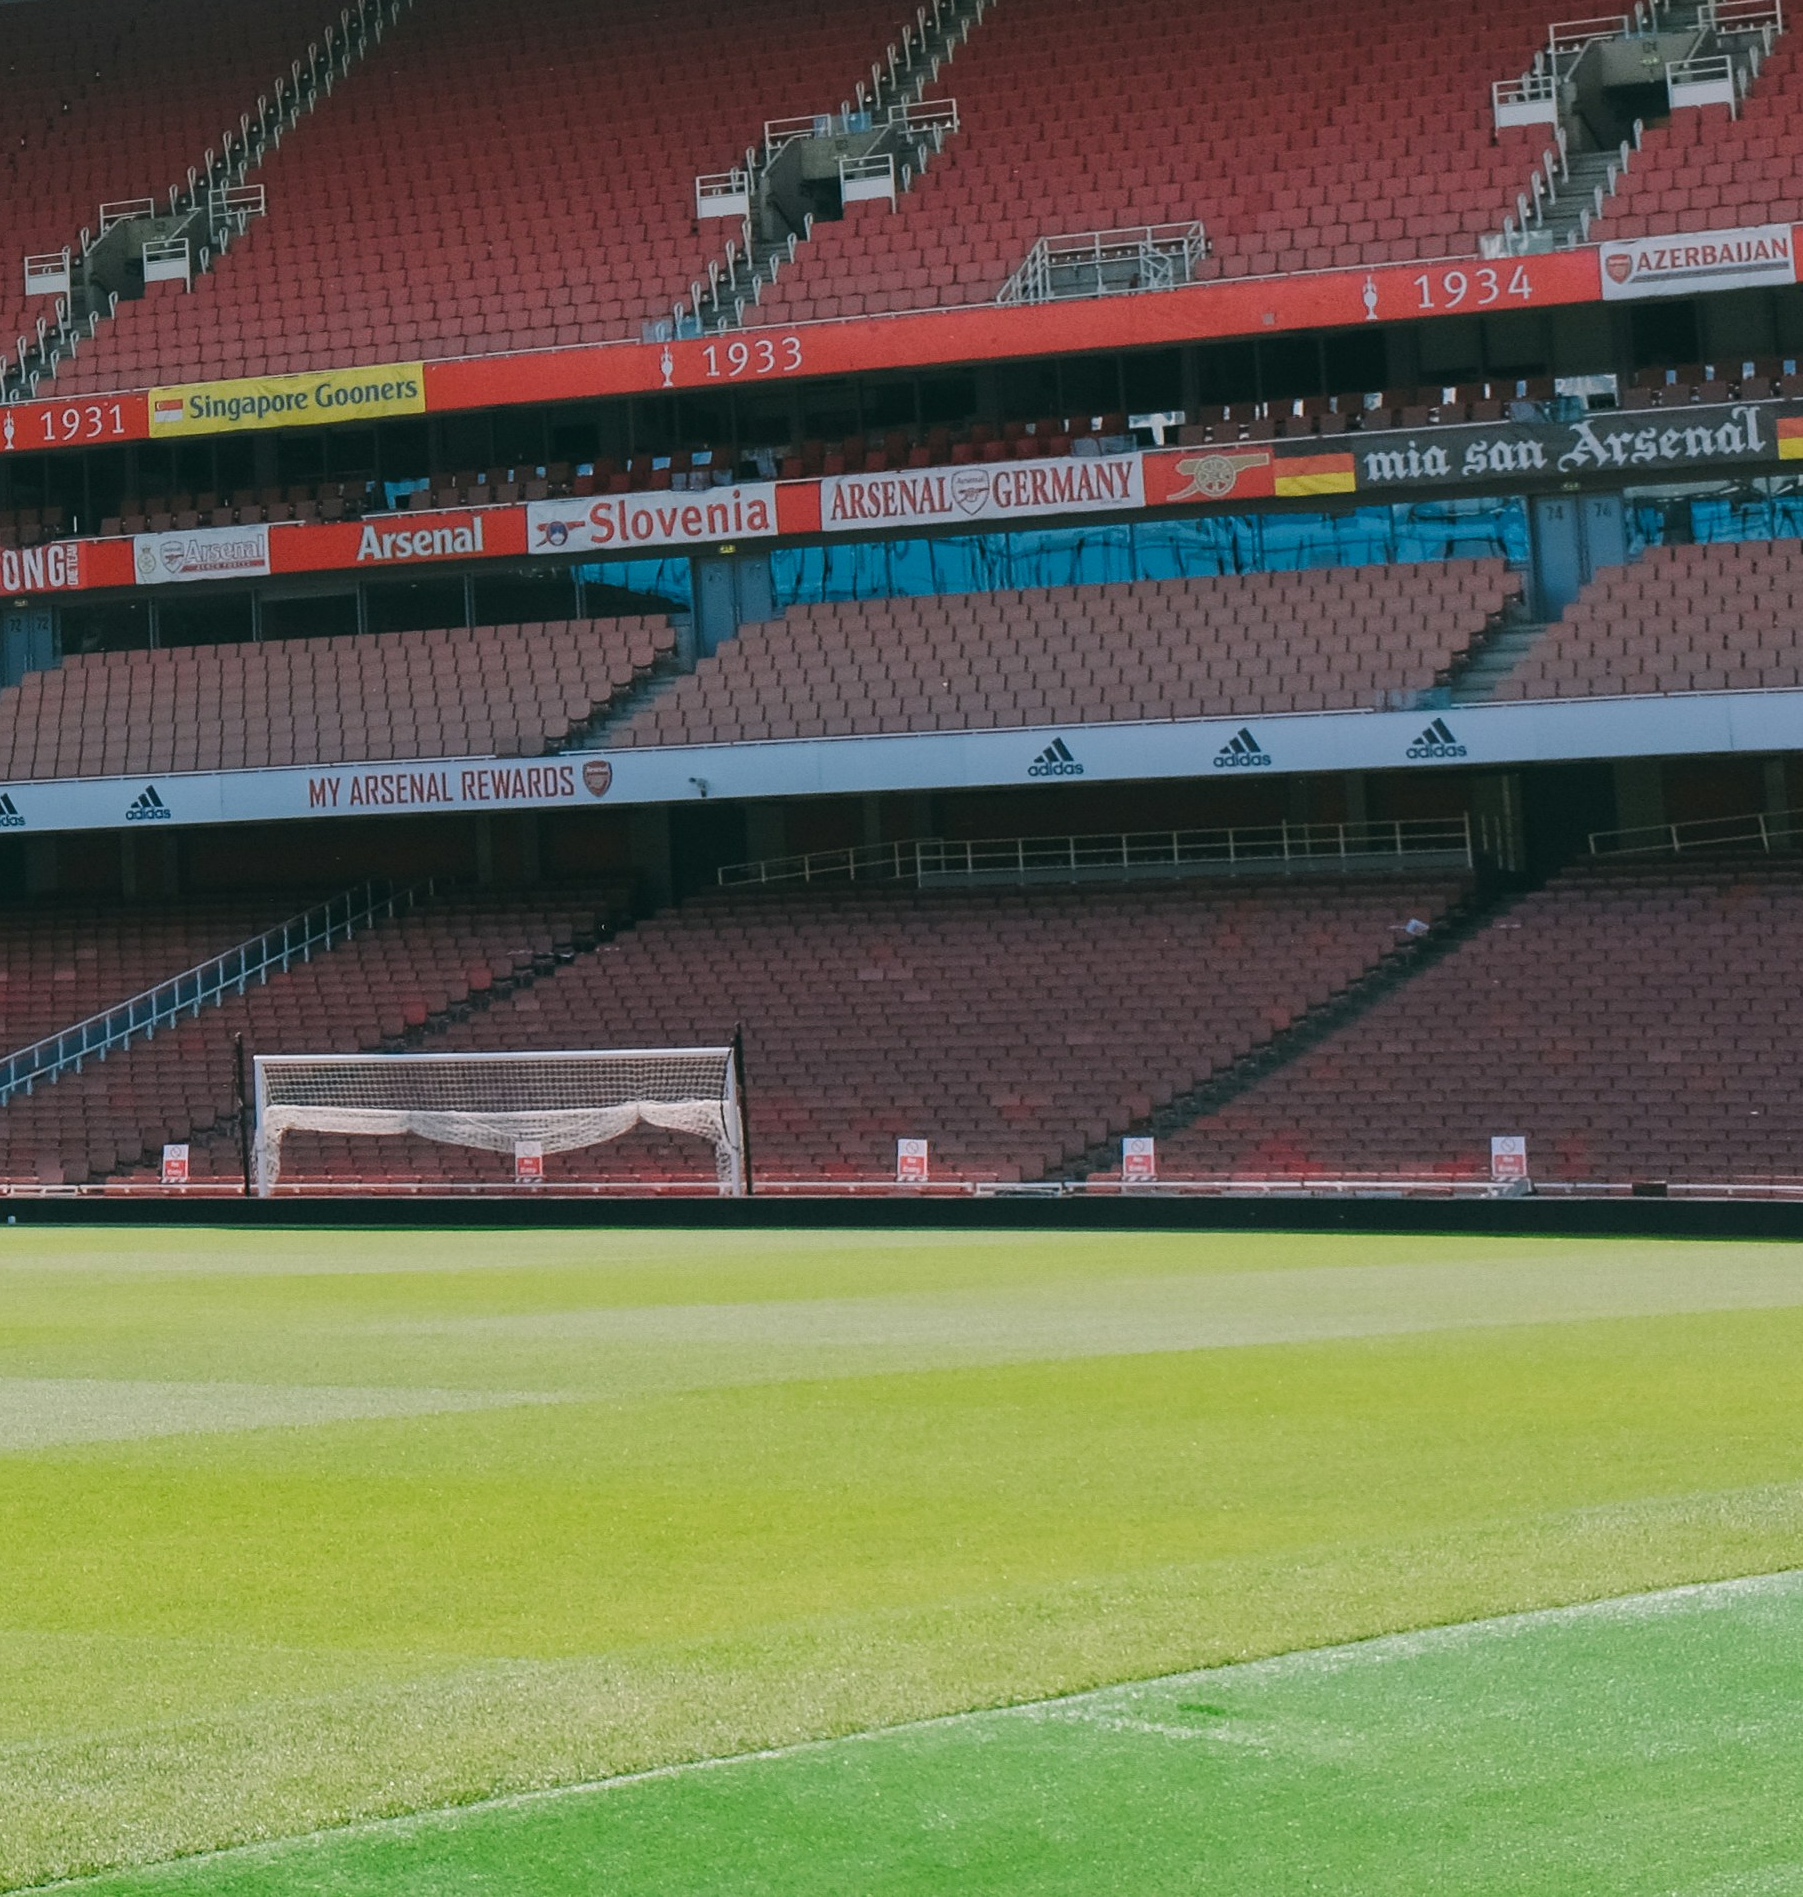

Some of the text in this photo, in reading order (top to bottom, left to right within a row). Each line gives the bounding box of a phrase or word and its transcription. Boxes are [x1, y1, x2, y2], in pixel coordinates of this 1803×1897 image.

[1636, 237, 1788, 272] AZERBAIJAN
[1413, 265, 1533, 309] 1934
[702, 336, 803, 377] 1933
[189, 378, 418, 422] Singapore Gooners
[40, 404, 125, 441] 1931
[1363, 405, 1766, 482] mia san Arsenal
[830, 461, 1134, 520] ARSENAL GERMANY
[590, 489, 769, 543] Slovenia
[184, 535, 264, 562] Arsenal
[357, 517, 484, 560] Arsenal
[1027, 762, 1084, 777] adidas
[1213, 752, 1272, 768] adidas
[1406, 742, 1467, 759] adidas
[309, 766, 575, 807] MY ARSENAL REWARDS
[126, 807, 171, 821] adidas
